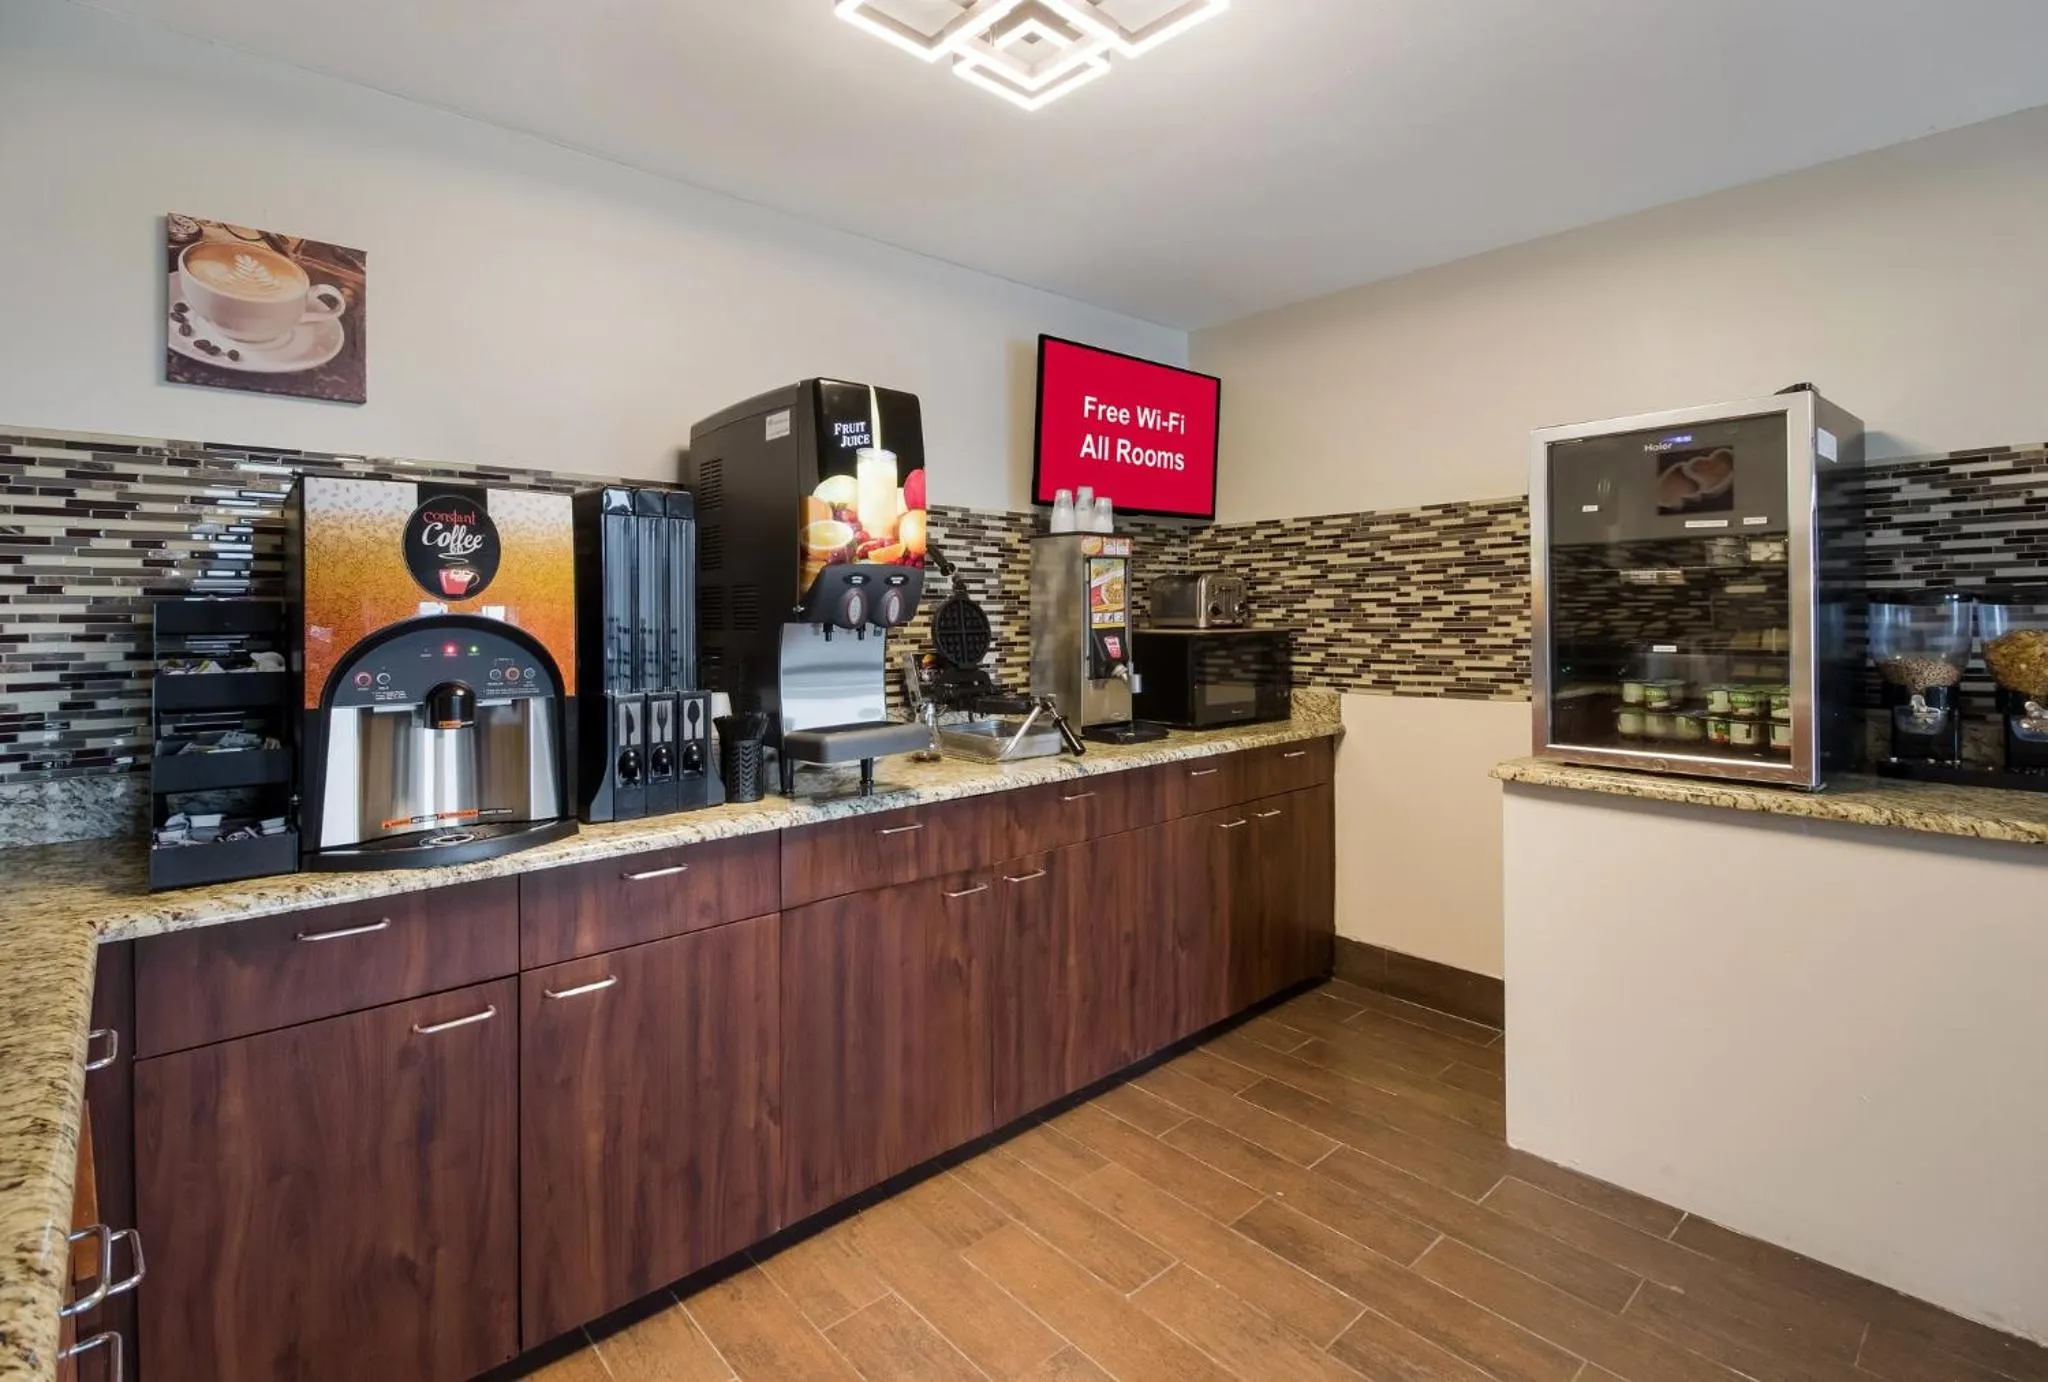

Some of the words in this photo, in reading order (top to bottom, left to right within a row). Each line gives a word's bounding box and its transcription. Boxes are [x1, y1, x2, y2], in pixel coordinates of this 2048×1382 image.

[1083, 395, 1131, 425] Free
[1136, 405, 1186, 436] Wi-Fi
[833, 421, 866, 436] FRUIT
[840, 433, 871, 448] JUICE
[1080, 433, 1110, 461] All
[1116, 438, 1185, 470] Rooms
[1643, 442, 1673, 452] Haier
[421, 522, 484, 554] Coffee
